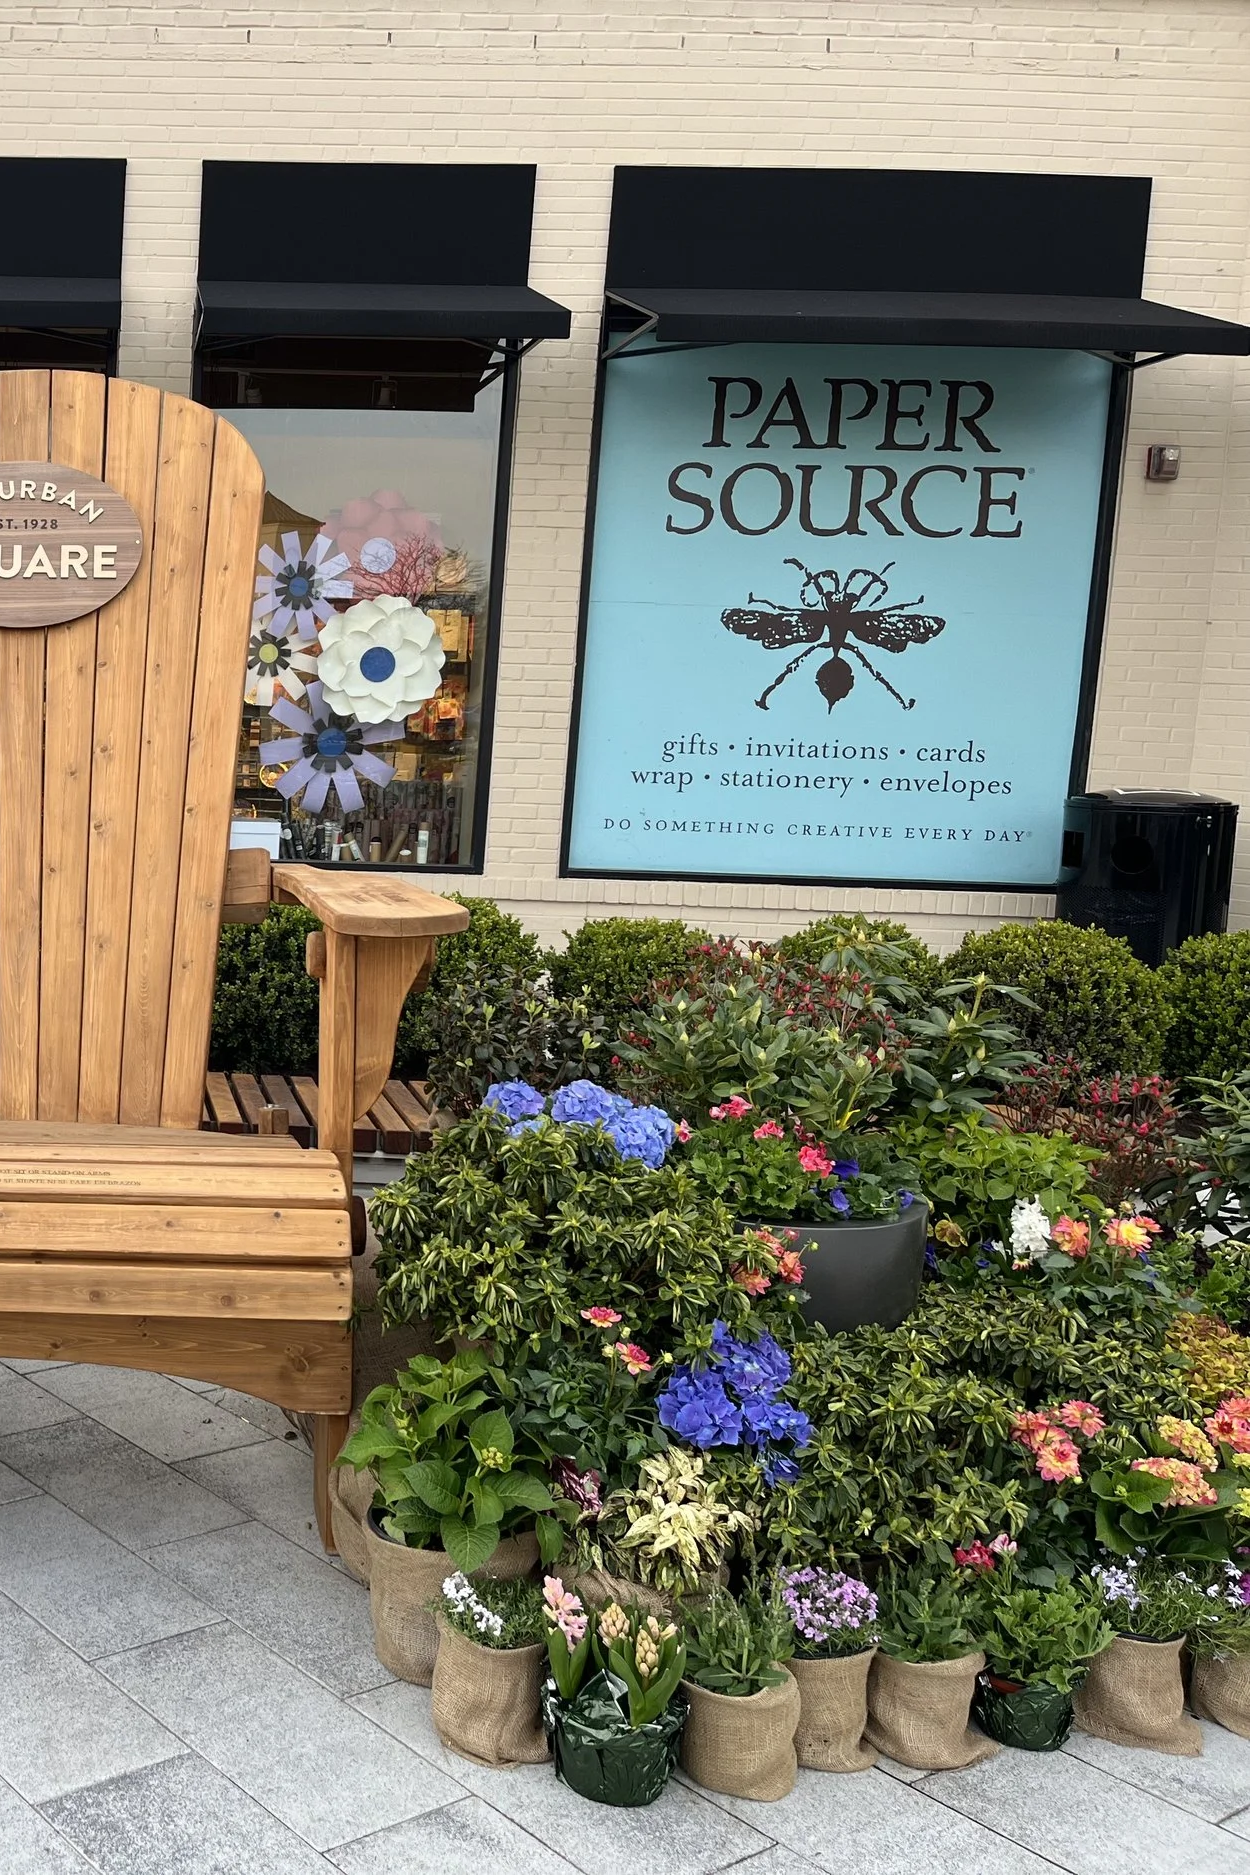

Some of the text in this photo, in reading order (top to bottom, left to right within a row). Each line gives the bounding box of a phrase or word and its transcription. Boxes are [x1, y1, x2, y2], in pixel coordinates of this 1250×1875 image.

[702, 376, 1002, 453] PAPER
[665, 462, 1026, 539] SOURCE
[23, 518, 59, 530] 1928
[661, 732, 987, 763] gifts invitations cards
[630, 768, 1013, 802] wrap stationery envelopes
[603, 818, 1026, 843] DO SOMETHING CREATIVE EVERY DAY
